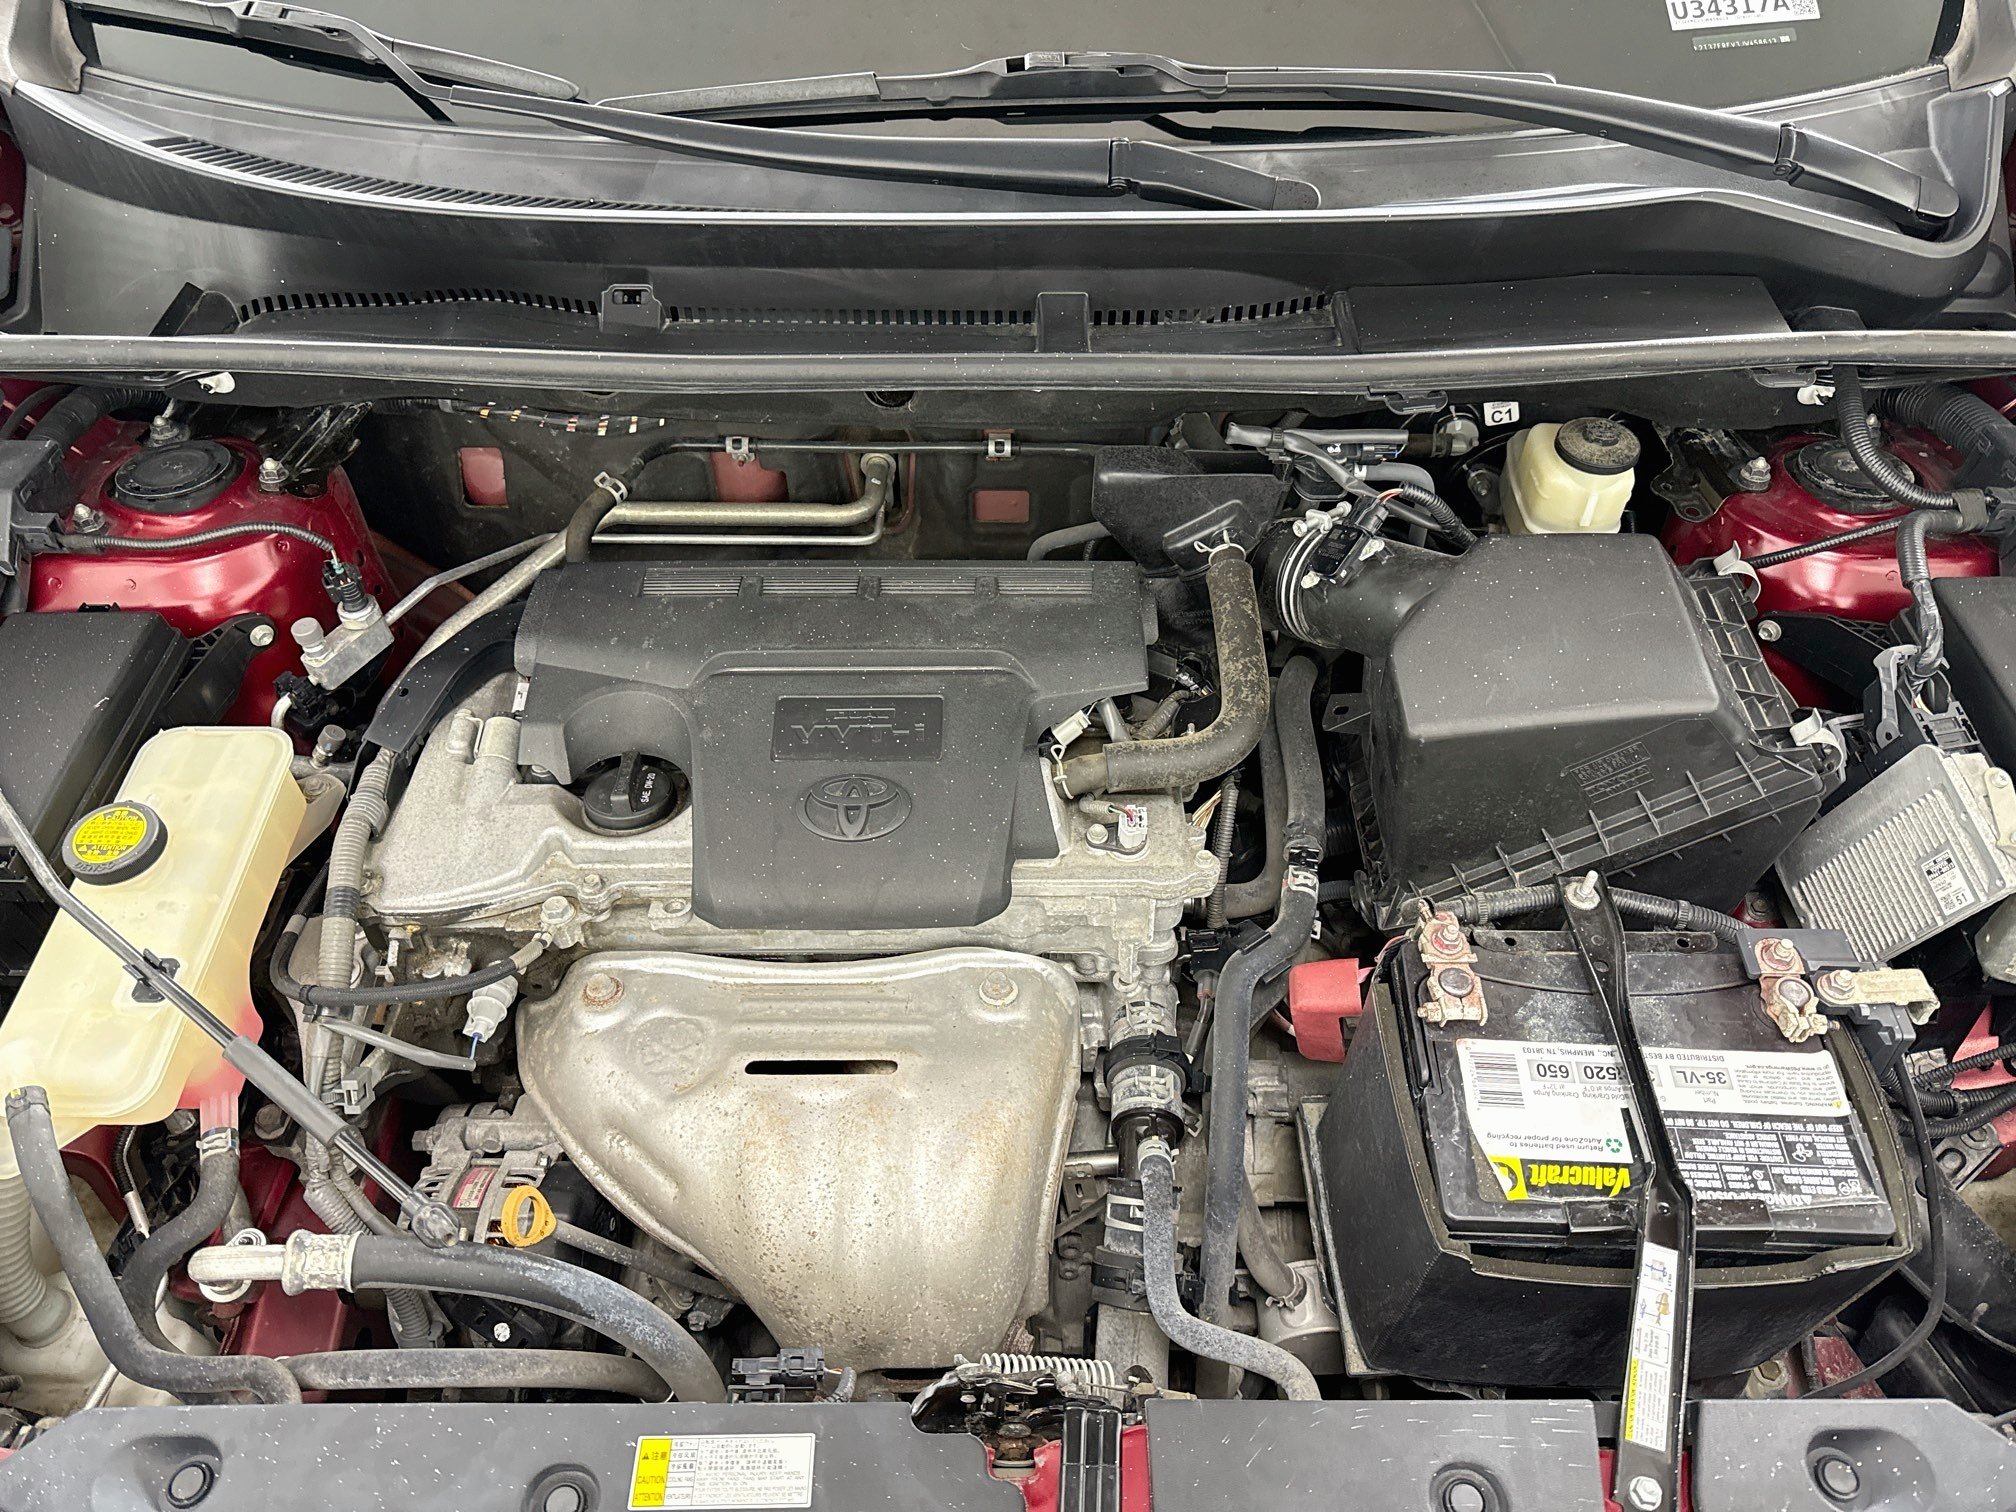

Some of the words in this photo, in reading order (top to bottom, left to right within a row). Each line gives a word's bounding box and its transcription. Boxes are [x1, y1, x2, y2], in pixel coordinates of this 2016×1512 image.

[1671, 0, 1791, 19] U34317A
[1491, 408, 1512, 423] C1
[640, 790, 652, 803] SAE
[73, 860, 116, 873] DENSO
[1522, 1047, 1545, 1055] 38103
[1557, 1047, 1595, 1057] MEMPHIS,
[1676, 1053, 1725, 1062] DISTRIBUTED
[1536, 1063, 1570, 1079] 650
[1675, 1070, 1727, 1085] 35-VL
[1552, 1090, 1580, 1099] Cranking
[1582, 1092, 1610, 1100] Cranking
[1694, 1089, 1720, 1097] Number
[1486, 1132, 1522, 1141] recycling
[1524, 1133, 1549, 1142] proper
[1564, 1137, 1602, 1145] AutoZone
[1519, 1141, 1554, 1150] batteries
[1556, 1143, 1575, 1151] used
[1577, 1144, 1603, 1152] Return
[1530, 1164, 1630, 1198] Valucraft
[651, 1451, 668, 1461] 注意
[637, 1476, 665, 1484] CAUTION
[634, 1493, 664, 1501] ATTENTION
